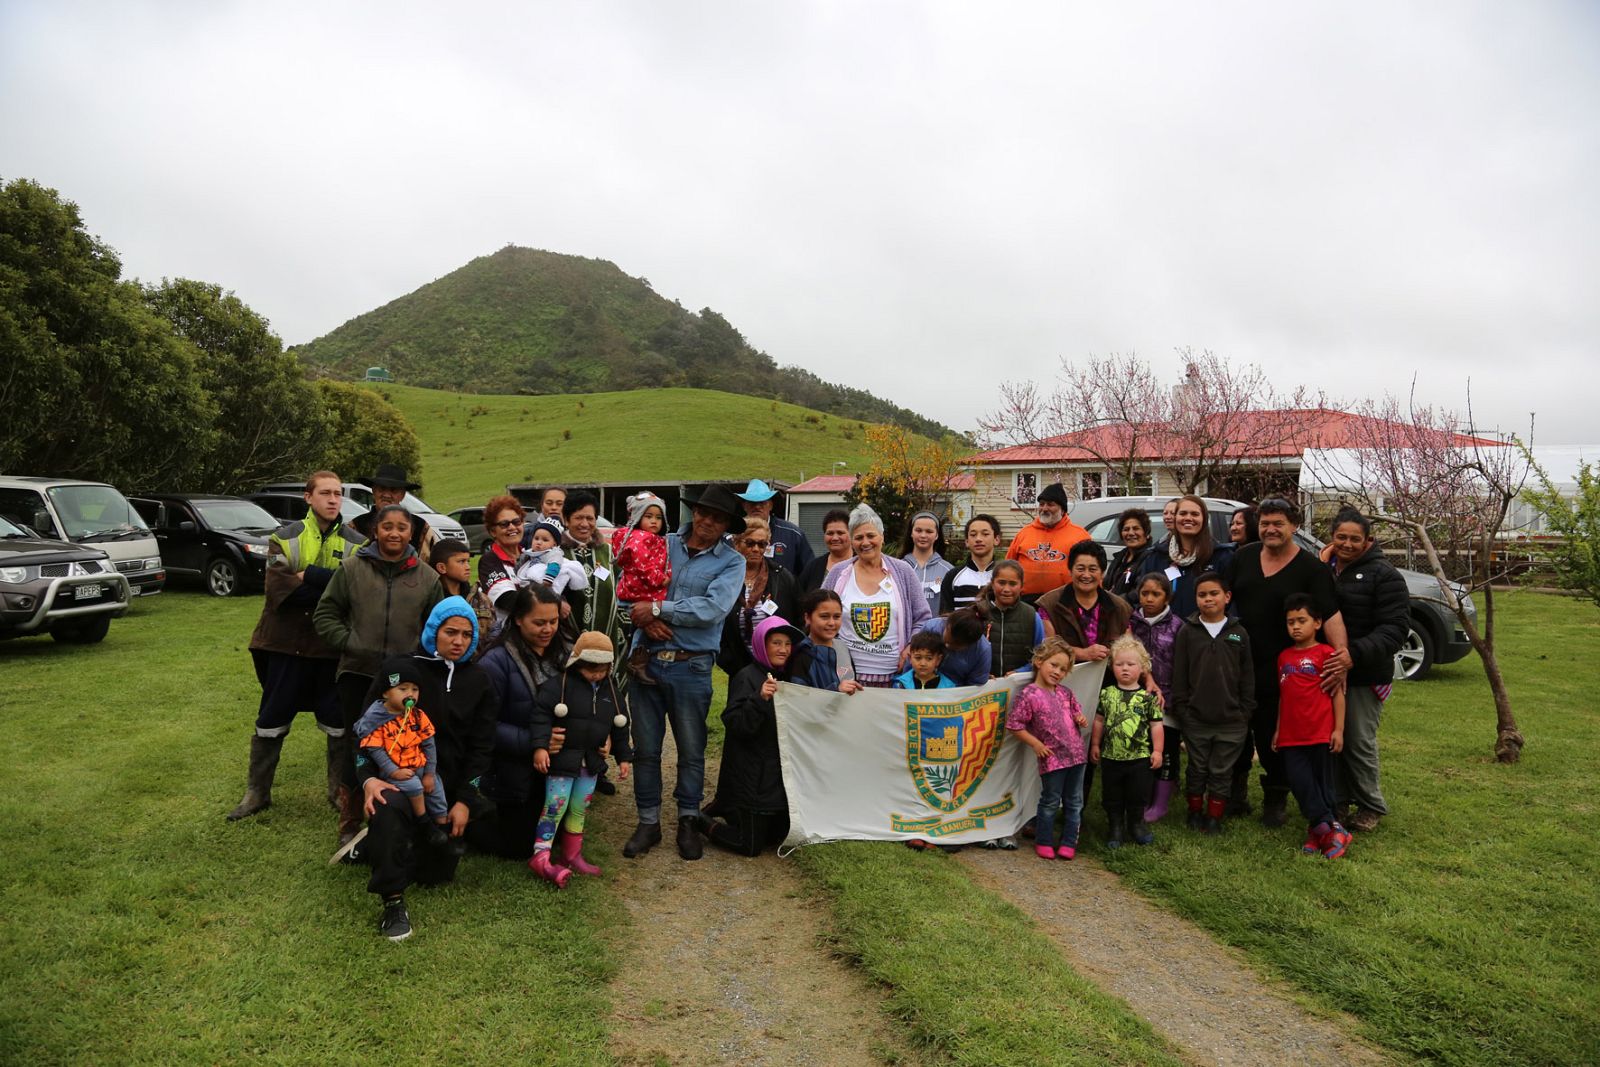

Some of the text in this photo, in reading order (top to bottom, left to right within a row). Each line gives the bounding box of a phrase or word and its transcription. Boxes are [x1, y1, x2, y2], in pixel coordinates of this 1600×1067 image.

[486, 571, 506, 587] 1929
[917, 695, 994, 714] MANUEL JOSE
[908, 717, 933, 799] ADELANTE
